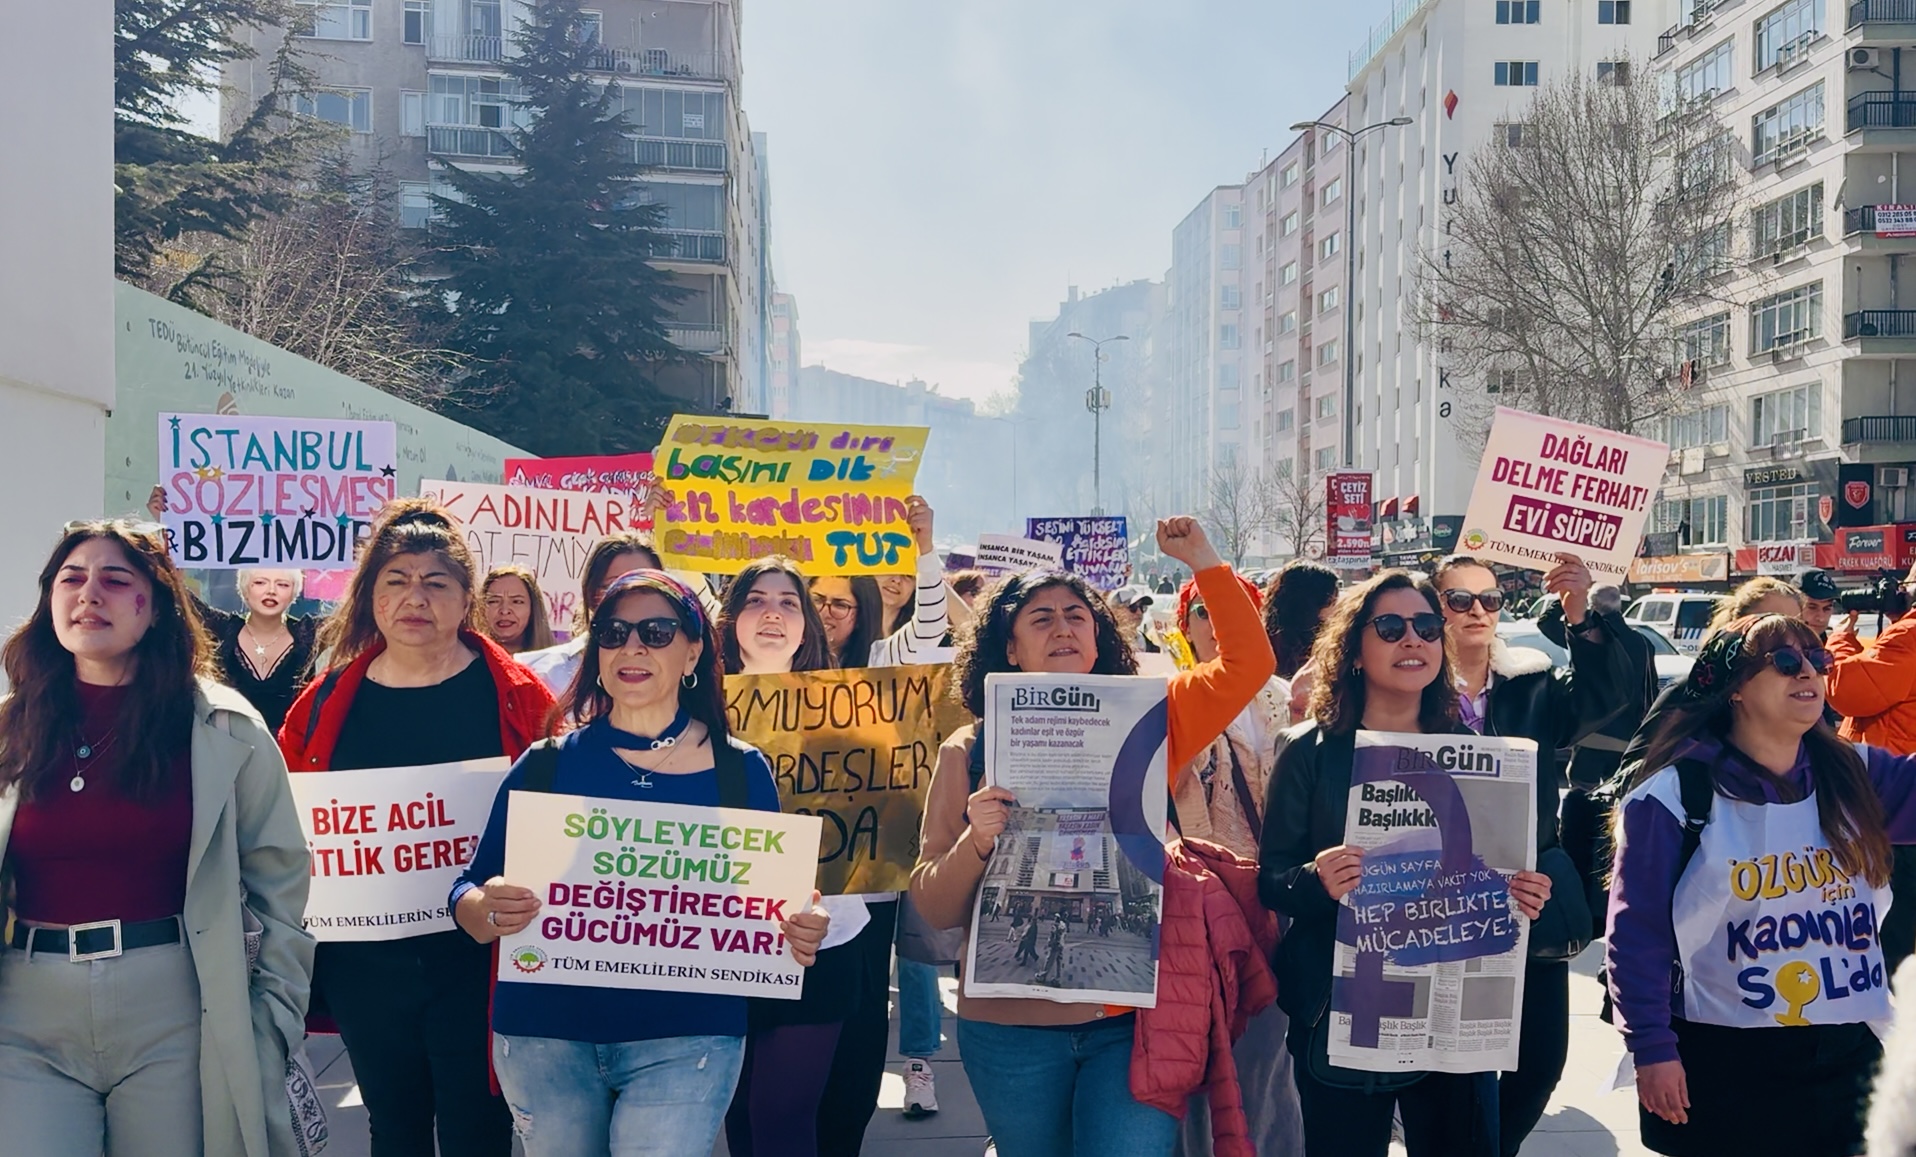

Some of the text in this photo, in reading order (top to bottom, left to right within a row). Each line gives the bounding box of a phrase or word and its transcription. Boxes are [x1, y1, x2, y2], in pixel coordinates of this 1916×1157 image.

[149, 318, 175, 343] TEDÜ
[177, 333, 210, 359] Bütüncül
[184, 362, 199, 379] 21.
[168, 415, 372, 471] İSTANBUL
[1540, 433, 1628, 475] DAĞLARI
[1492, 457, 1648, 512] DELME FERHAT!
[439, 489, 624, 536] KADINLAR
[1509, 503, 1552, 535] EVİ
[1552, 509, 1617, 549] SÜPÜR
[511, 533, 594, 580] ETMİY
[826, 531, 912, 567] TUT
[1490, 540, 1516, 552] TÜM
[1849, 535, 1884, 550] Forever
[1011, 715, 1111, 727] Tek adam rejimi kaybedecek
[1011, 727, 1040, 736] kadınlar
[1041, 728, 1054, 737] eşit
[1065, 728, 1084, 738] özgür
[1010, 739, 1084, 749] bir yaşamı kazanacak
[311, 792, 455, 835] BİZE ACİL
[564, 807, 786, 854] SÖYLEYECEK
[1358, 808, 1437, 831] Başlıkkk
[593, 846, 752, 885] SÖZÜMÜZ
[1401, 860, 1442, 874] SAYFA
[1438, 871, 1466, 889] VAKİT
[1470, 869, 1492, 882] YOK
[1728, 847, 1850, 901] ÖZGÜR
[548, 880, 787, 922] DEĞİŞTİRECEK
[1821, 884, 1856, 905] için
[337, 908, 433, 927] EMEKLİLERİN
[1354, 902, 1395, 924] HEP
[541, 911, 786, 956] GÜCÜMÜZ VAR!
[1355, 913, 1513, 954] MÜCADELEYE!
[551, 957, 801, 986] TÜM EMEKLİLERİN SENDİKASI
[1400, 1020, 1427, 1031] Başlık
